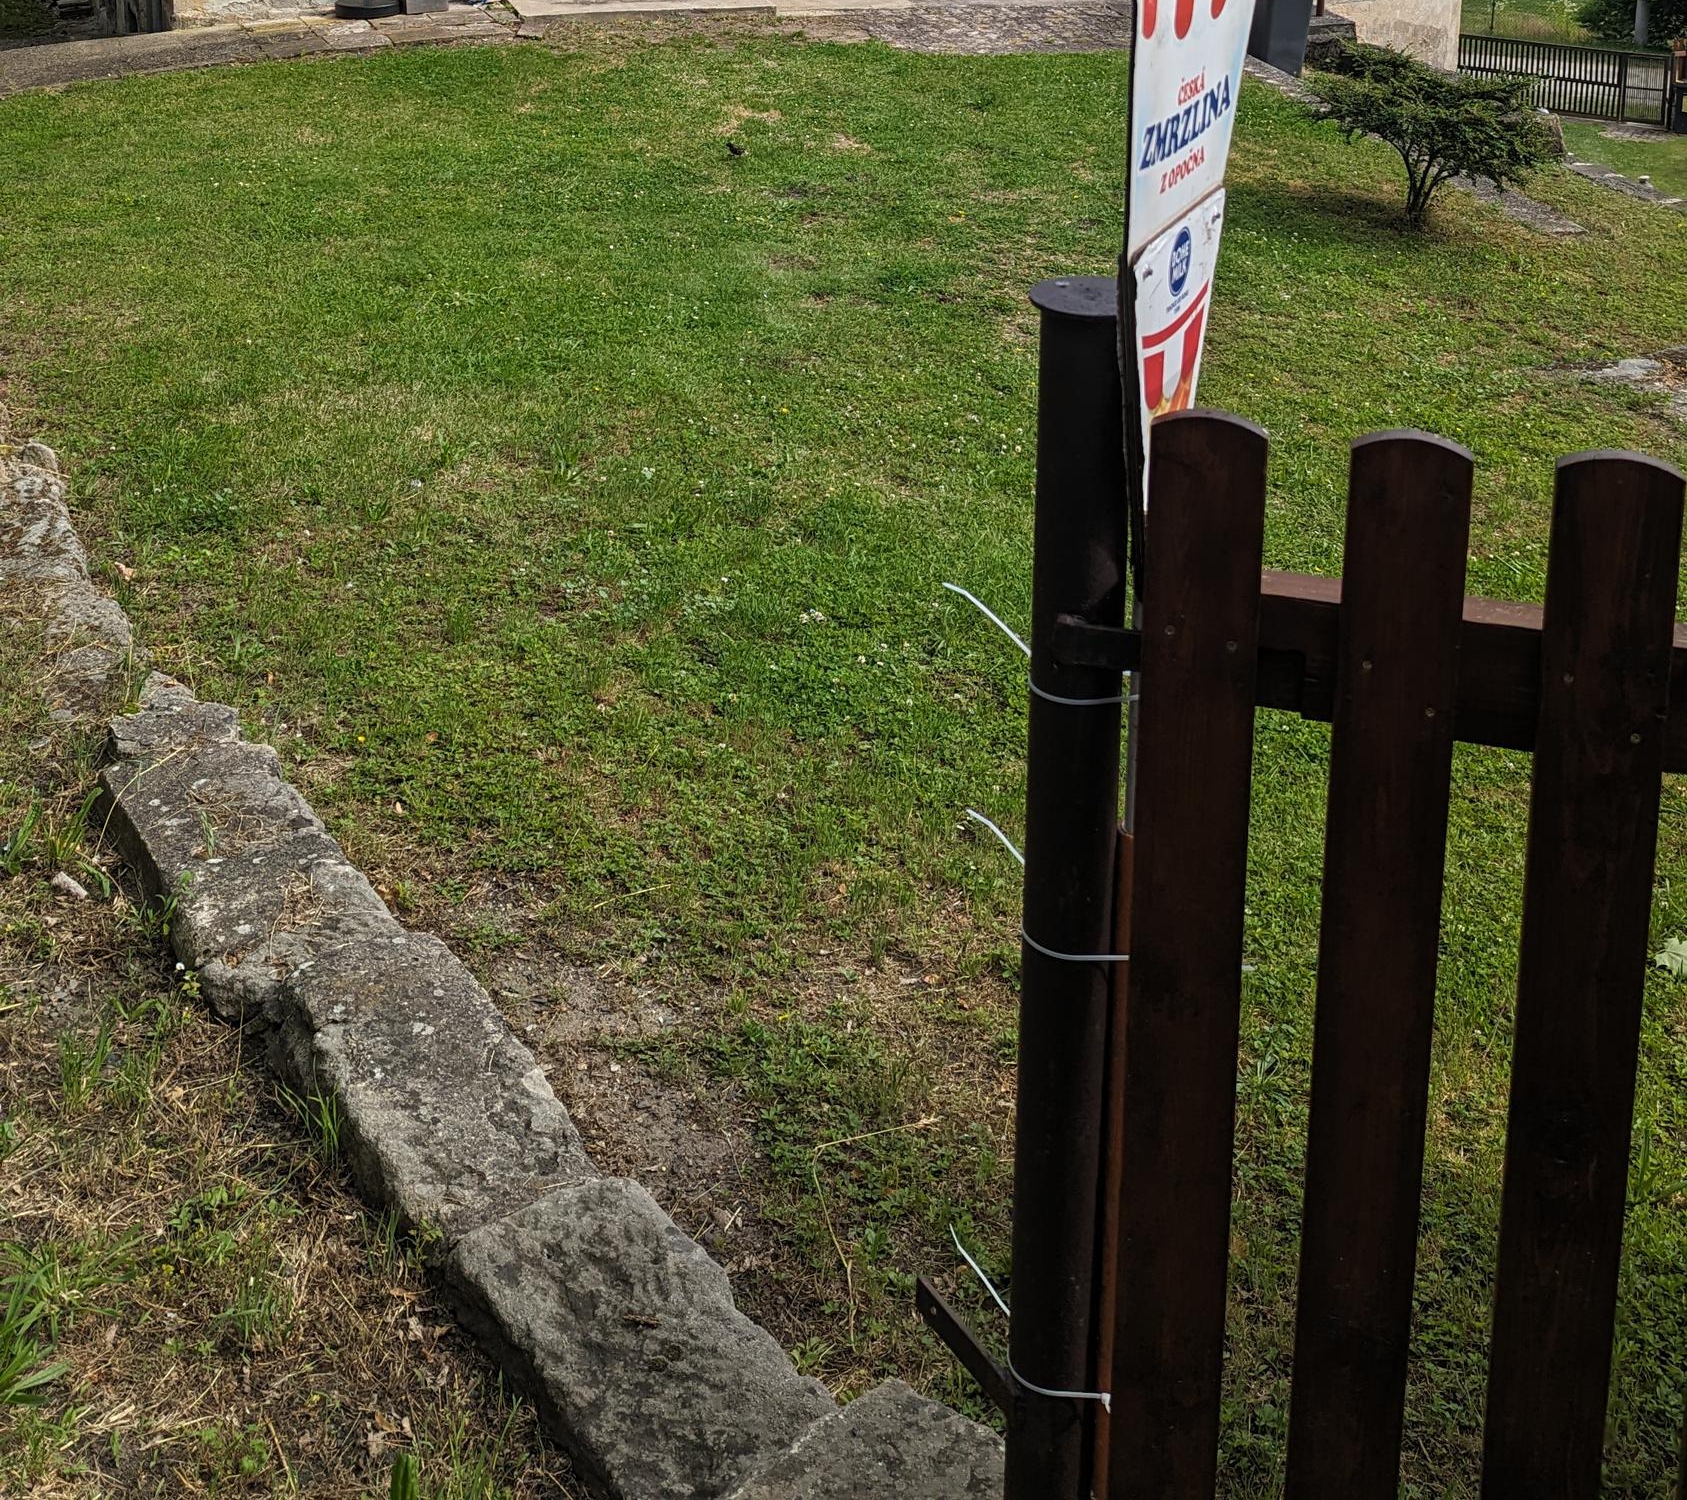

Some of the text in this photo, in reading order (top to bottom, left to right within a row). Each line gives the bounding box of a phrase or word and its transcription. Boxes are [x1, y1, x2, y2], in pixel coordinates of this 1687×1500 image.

[1178, 66, 1206, 105] ČESKÁ
[1139, 74, 1231, 170] ZMRZLINA
[1160, 146, 1205, 194] Z OPOČNA
[1171, 258, 1187, 284] MILK
